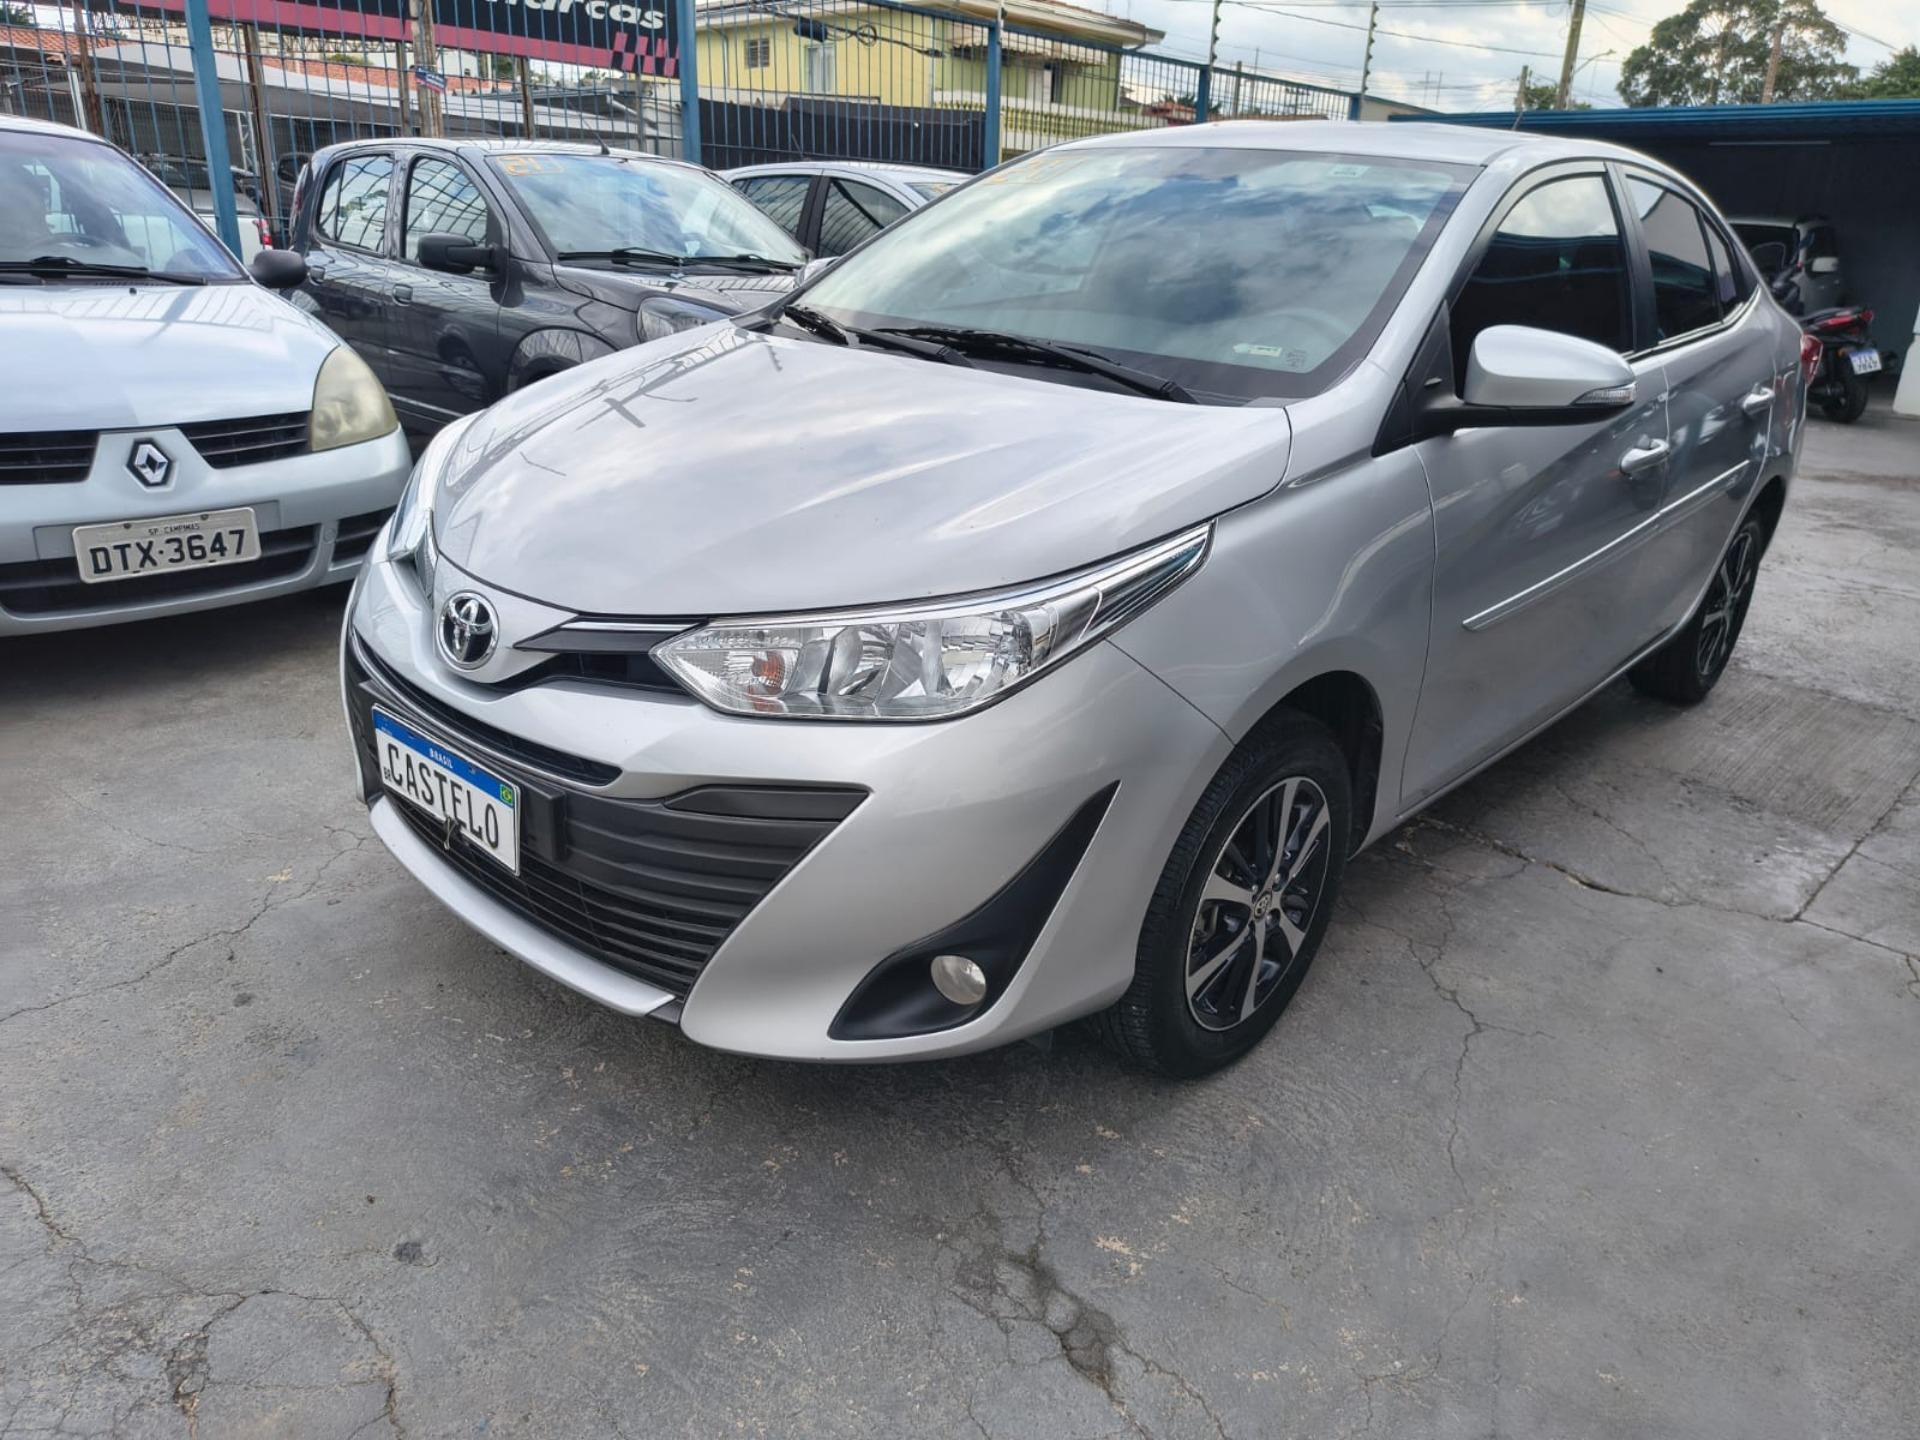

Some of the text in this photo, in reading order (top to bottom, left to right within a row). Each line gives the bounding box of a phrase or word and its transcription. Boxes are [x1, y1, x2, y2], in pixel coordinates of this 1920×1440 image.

[486, 0, 664, 30] arcas
[429, 747, 453, 769] BRASIL
[387, 742, 499, 849] CASTELO
